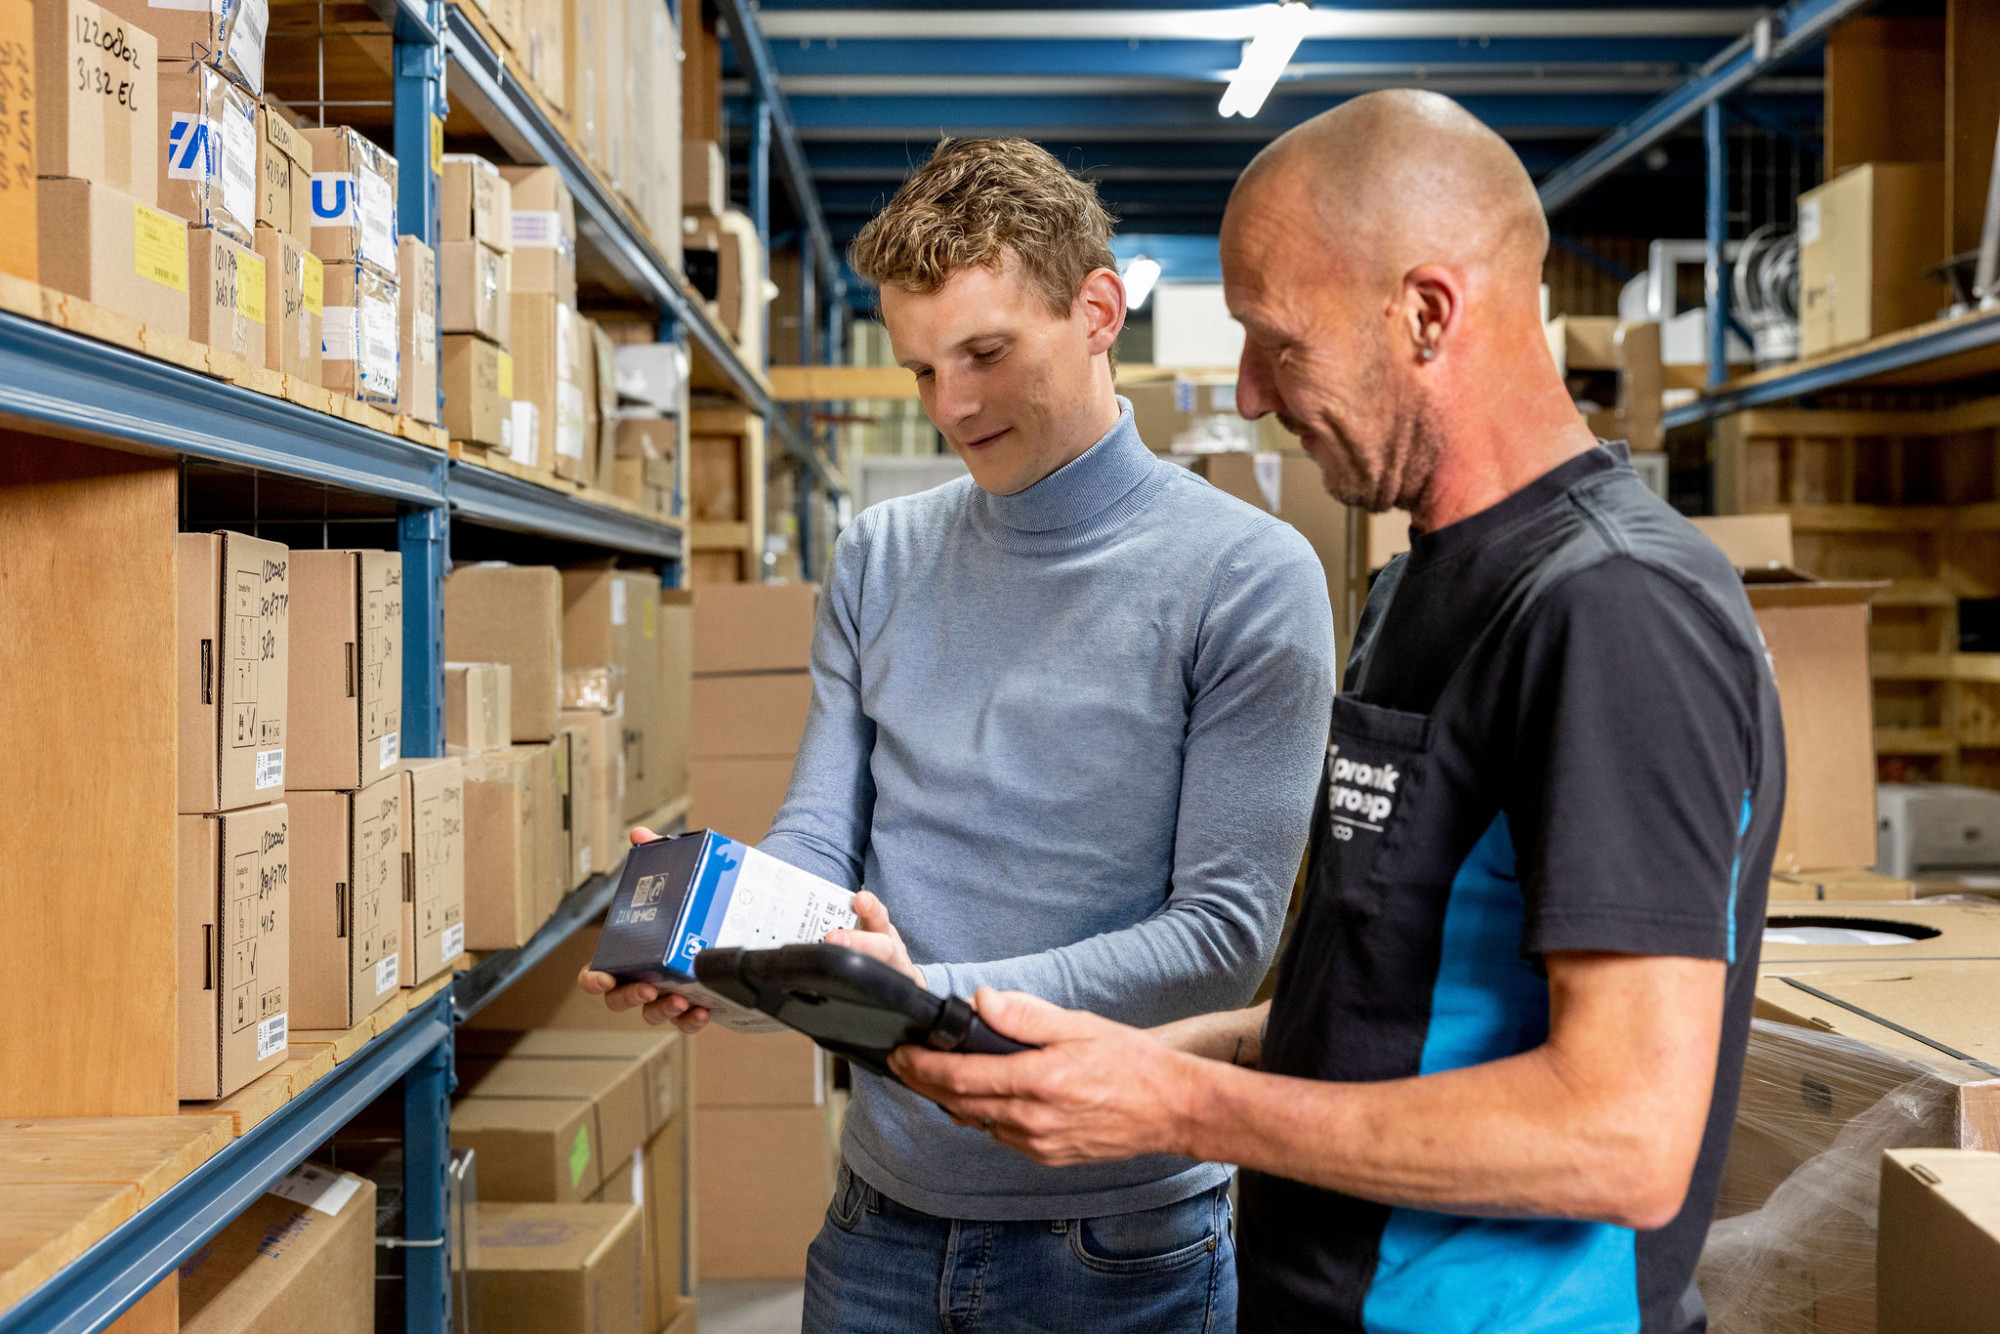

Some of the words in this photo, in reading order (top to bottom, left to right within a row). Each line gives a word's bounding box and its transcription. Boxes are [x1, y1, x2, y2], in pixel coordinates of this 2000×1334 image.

[76, 14, 140, 70] 1220802
[78, 56, 113, 95] 3132
[260, 910, 276, 935] 415
